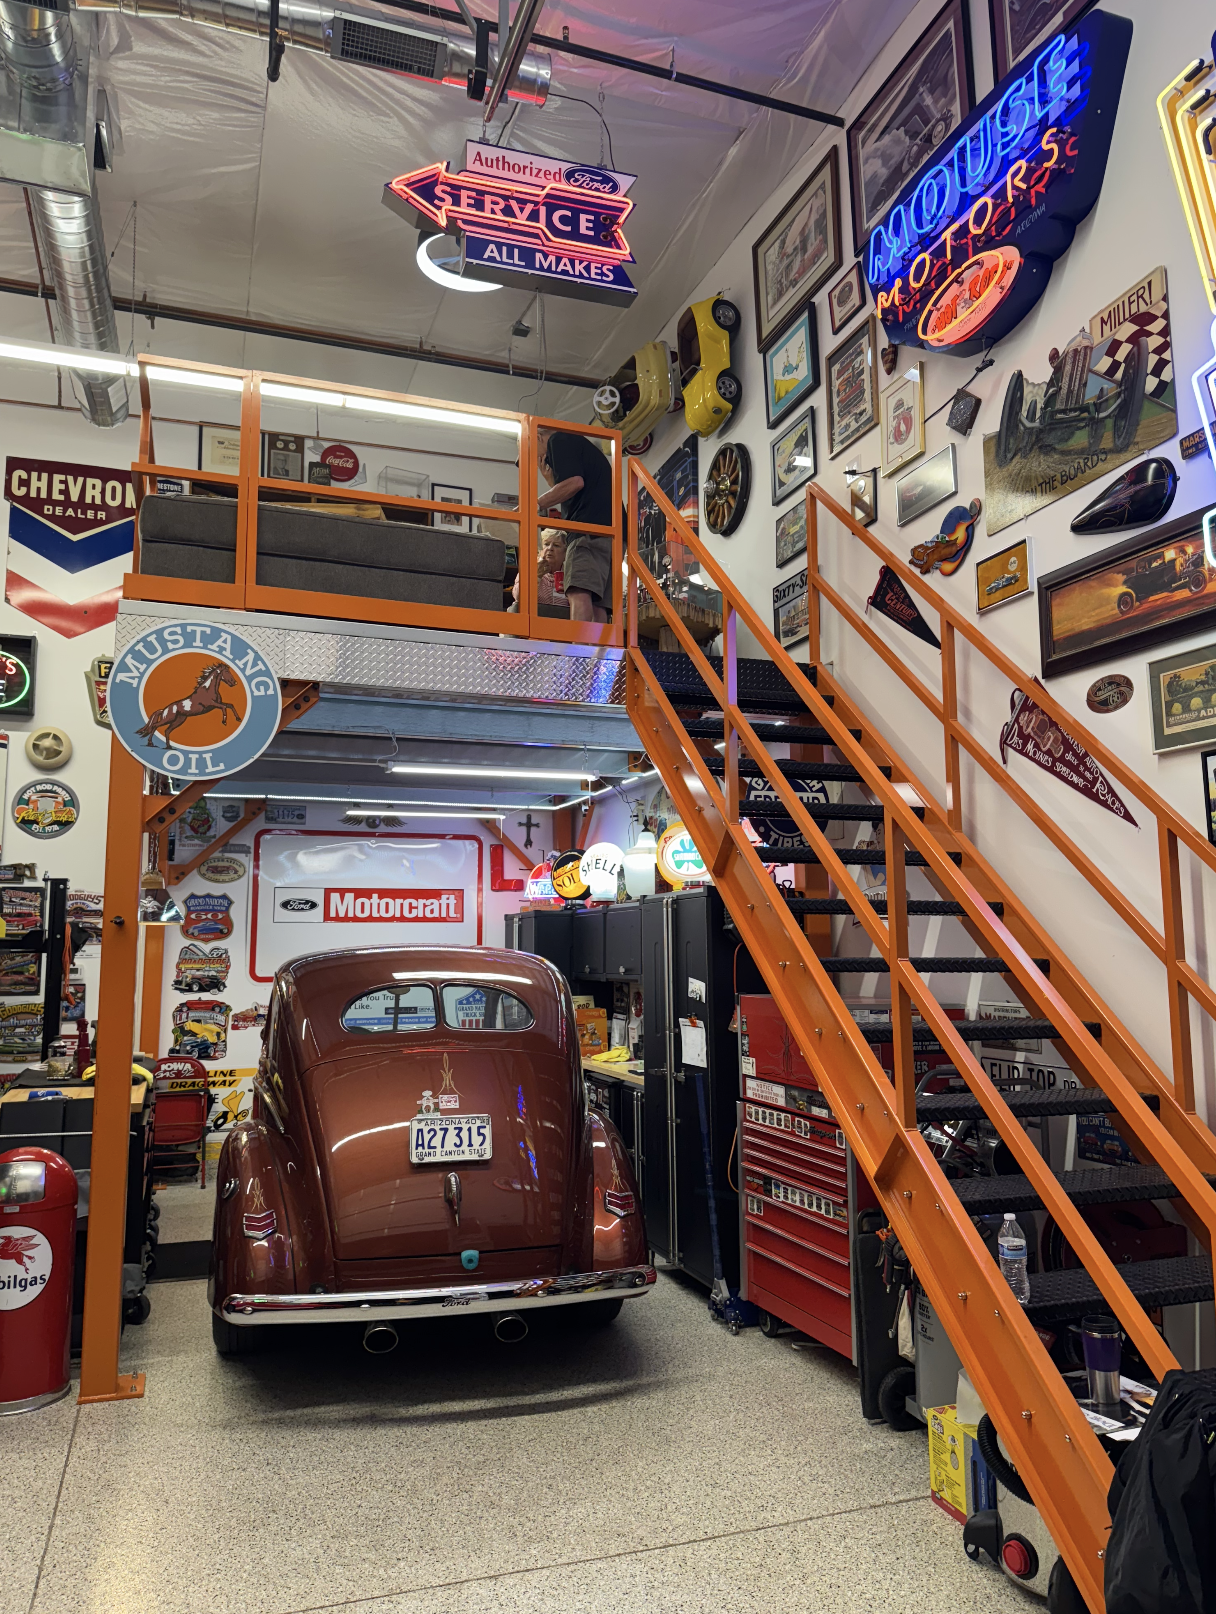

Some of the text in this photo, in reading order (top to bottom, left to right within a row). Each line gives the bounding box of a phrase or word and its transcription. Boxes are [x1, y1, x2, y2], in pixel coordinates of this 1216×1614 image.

[472, 150, 613, 194] Authorized Ford
[433, 185, 595, 236] SERVICE
[877, 128, 1075, 319] MOTORS
[483, 243, 614, 282] ALL MAKES
[1100, 279, 1153, 339] MILLER!
[1038, 478, 1058, 497] THE
[1060, 447, 1108, 486] BOARDS
[11, 469, 137, 509] CHEVRON
[157, 483, 182, 492] RESTONE
[43, 505, 107, 521] DEALER
[885, 590, 917, 618] CENTURY
[115, 625, 274, 697] MUSTANG
[1199, 706, 1216, 718] AD
[1006, 721, 1023, 750] DES
[1023, 738, 1053, 767] MOINES
[162, 750, 225, 774] OIL
[1084, 753, 1101, 777] AUTO
[22, 783, 71, 801] HOT ROD PARTS
[1092, 775, 1125, 817] RACES
[276, 809, 296, 820] 1175
[581, 858, 617, 876] SHELL
[556, 872, 580, 892] SOL
[187, 898, 229, 907] GRAND NATIONAL
[287, 892, 457, 918] Ford Motorcraft
[155, 1071, 178, 1079] GAS
[161, 1062, 192, 1071] IOWA
[169, 1079, 238, 1090] DRAGWAY
[755, 1083, 774, 1092] NOTICE
[1027, 1067, 1056, 1090] TOP
[752, 1091, 779, 1104] PROHIBITED
[424, 1119, 463, 1127] ARIZONA
[1089, 1117, 1103, 1126] CAN'T
[416, 1148, 487, 1158] GRAND CANYON STATE
[0, 1273, 47, 1292] bilgas
[442, 1297, 471, 1308] Ford
